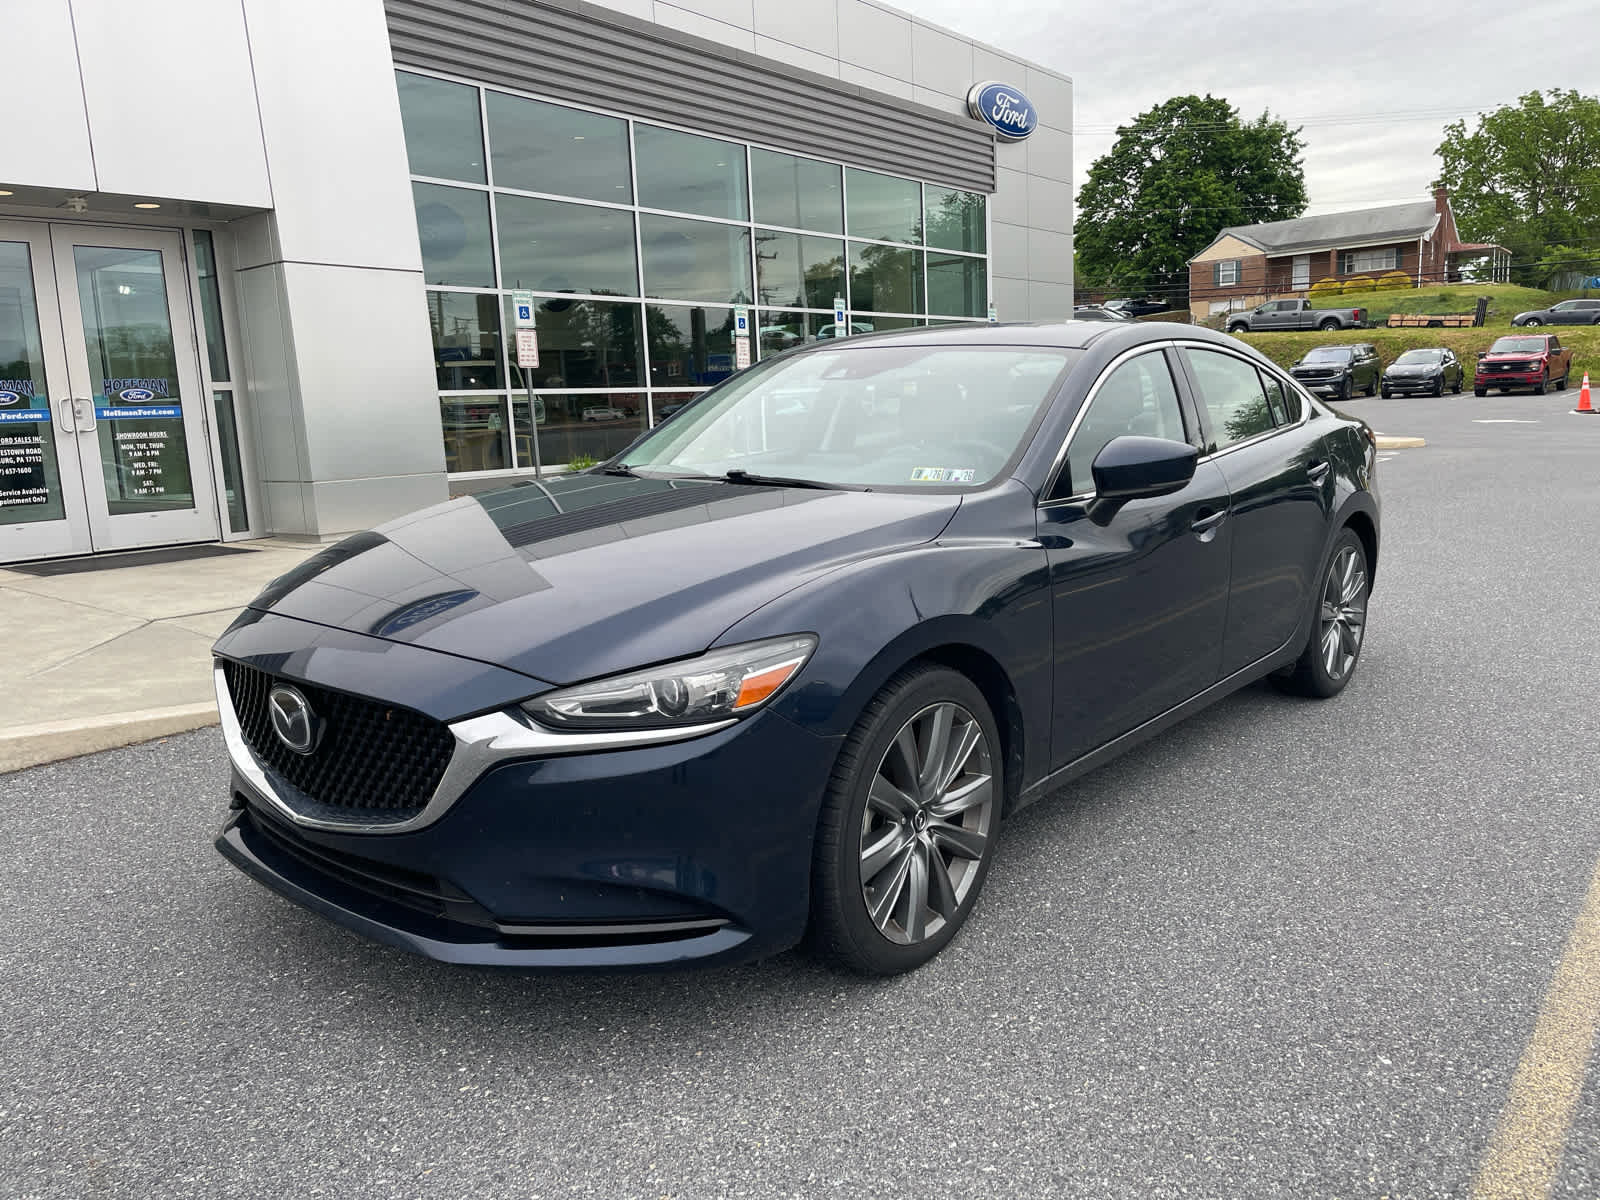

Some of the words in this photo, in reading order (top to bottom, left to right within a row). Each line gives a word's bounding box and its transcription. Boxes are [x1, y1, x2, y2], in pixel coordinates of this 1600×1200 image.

[992, 92, 1028, 129] Ford
[103, 378, 169, 398] HOFFMAN
[127, 391, 147, 400] Ford
[14, 436, 32, 444] SALES
[116, 432, 148, 440] SHOWROOM
[21, 487, 49, 496] Available
[32, 496, 47, 504] Only
